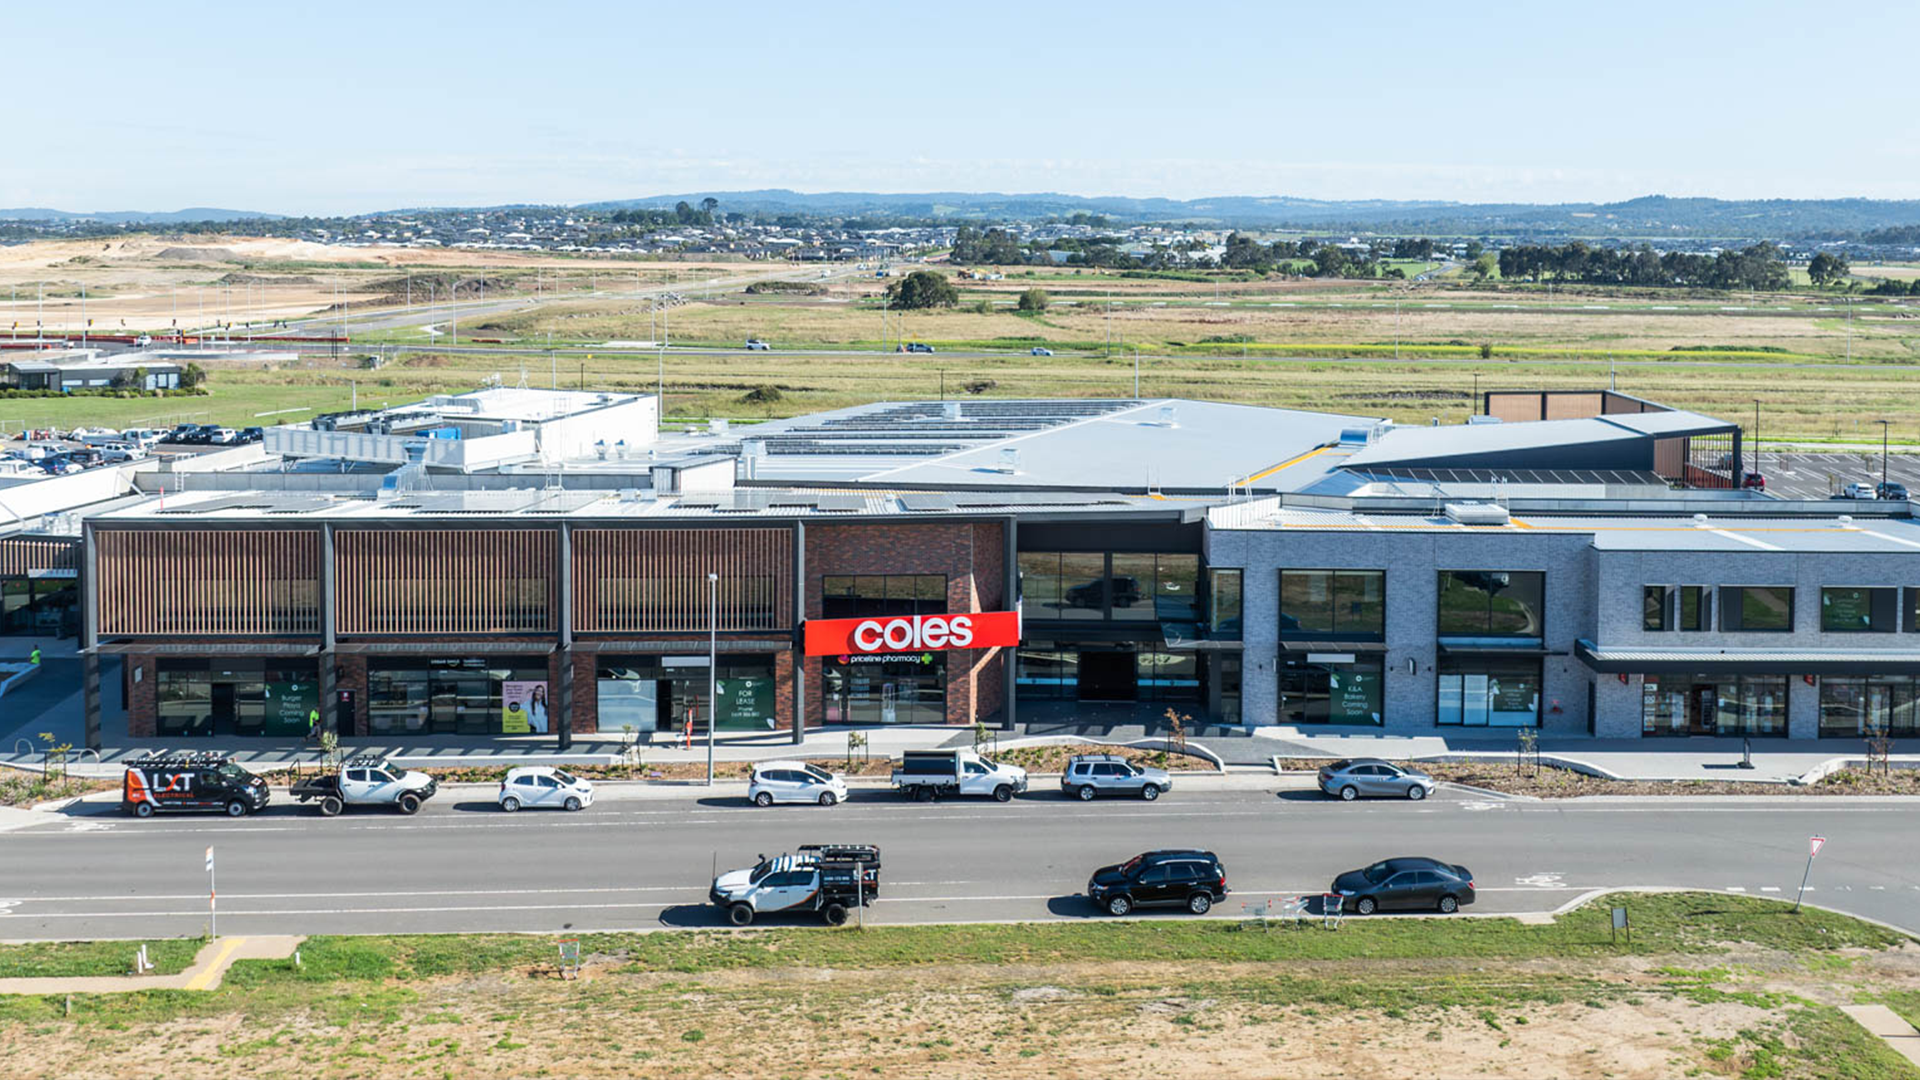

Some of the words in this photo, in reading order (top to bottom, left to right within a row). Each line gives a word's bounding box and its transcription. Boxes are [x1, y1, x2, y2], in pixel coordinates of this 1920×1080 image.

[854, 615, 974, 652] coles
[851, 655, 881, 664] priceline
[882, 654, 920, 664] pharmacy
[281, 694, 302, 702] Burger
[1344, 693, 1366, 701] Bakery
[1342, 701, 1368, 709] Coming
[153, 773, 195, 791] LXT
